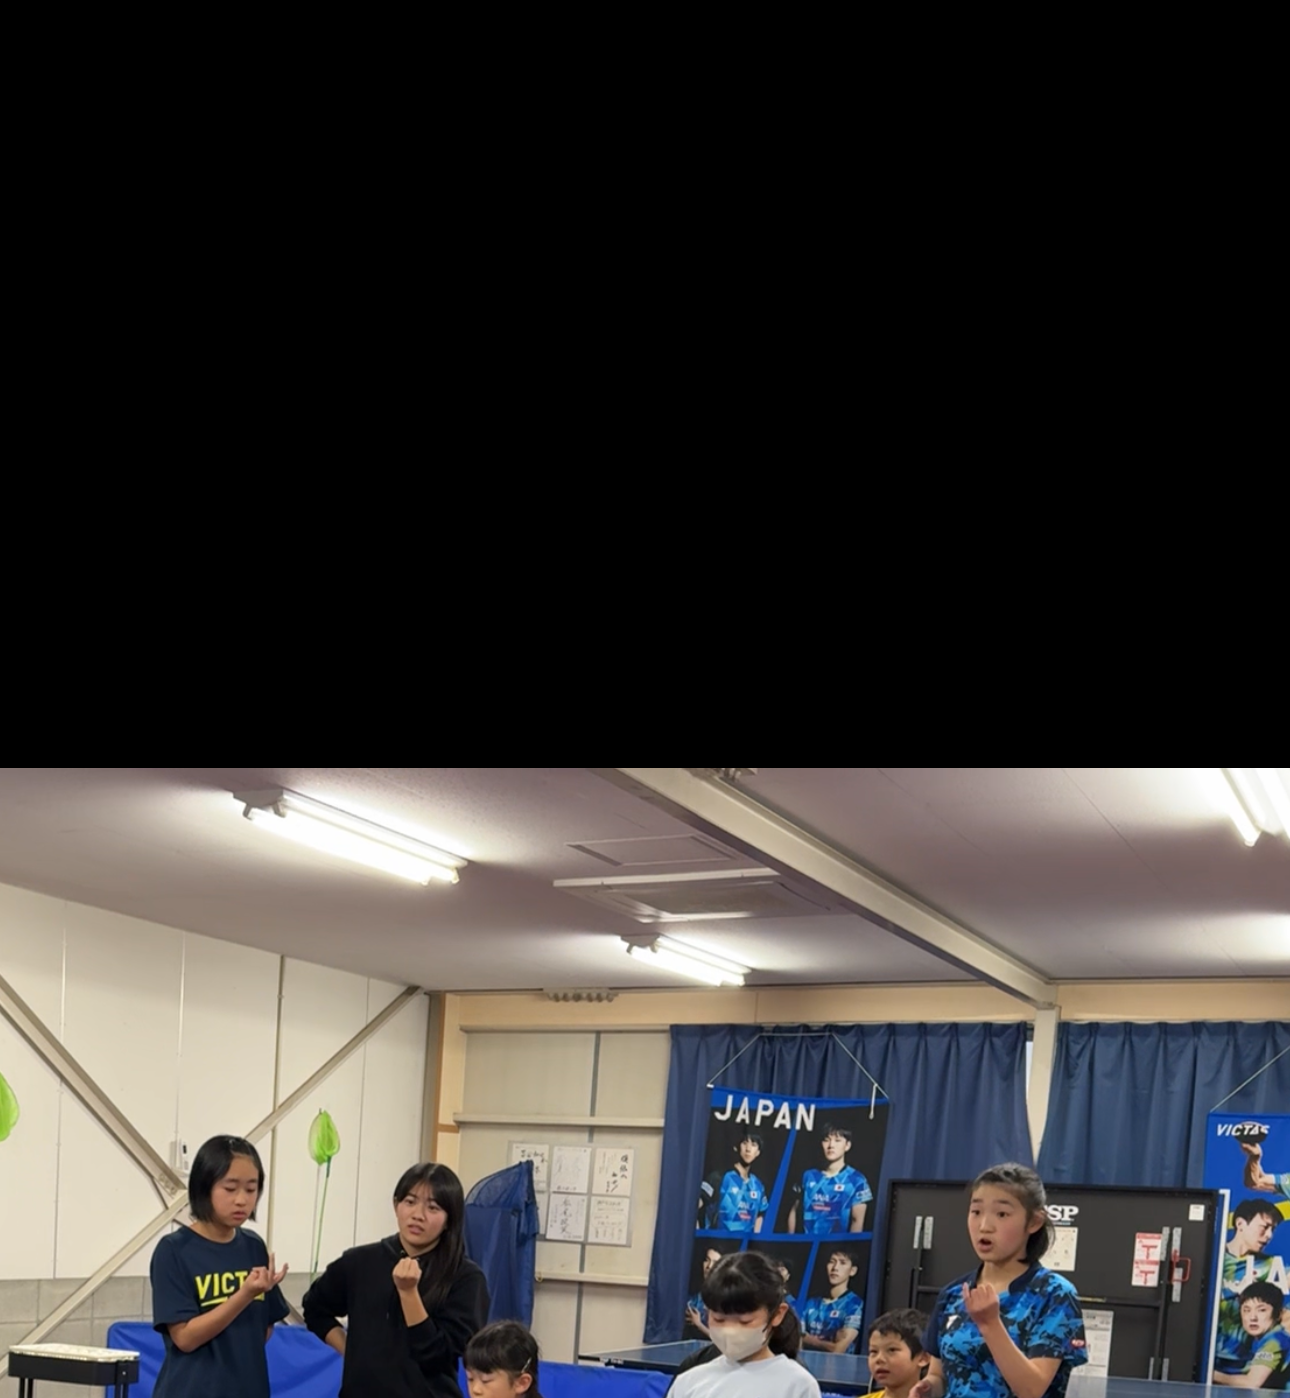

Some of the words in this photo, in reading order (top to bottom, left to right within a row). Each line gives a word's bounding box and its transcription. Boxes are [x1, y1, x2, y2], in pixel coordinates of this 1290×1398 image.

[714, 1094, 816, 1132] JAPAN
[1217, 1123, 1270, 1137] VICTAS
[1044, 1204, 1079, 1221] SP
[194, 1270, 249, 1300] VICT
